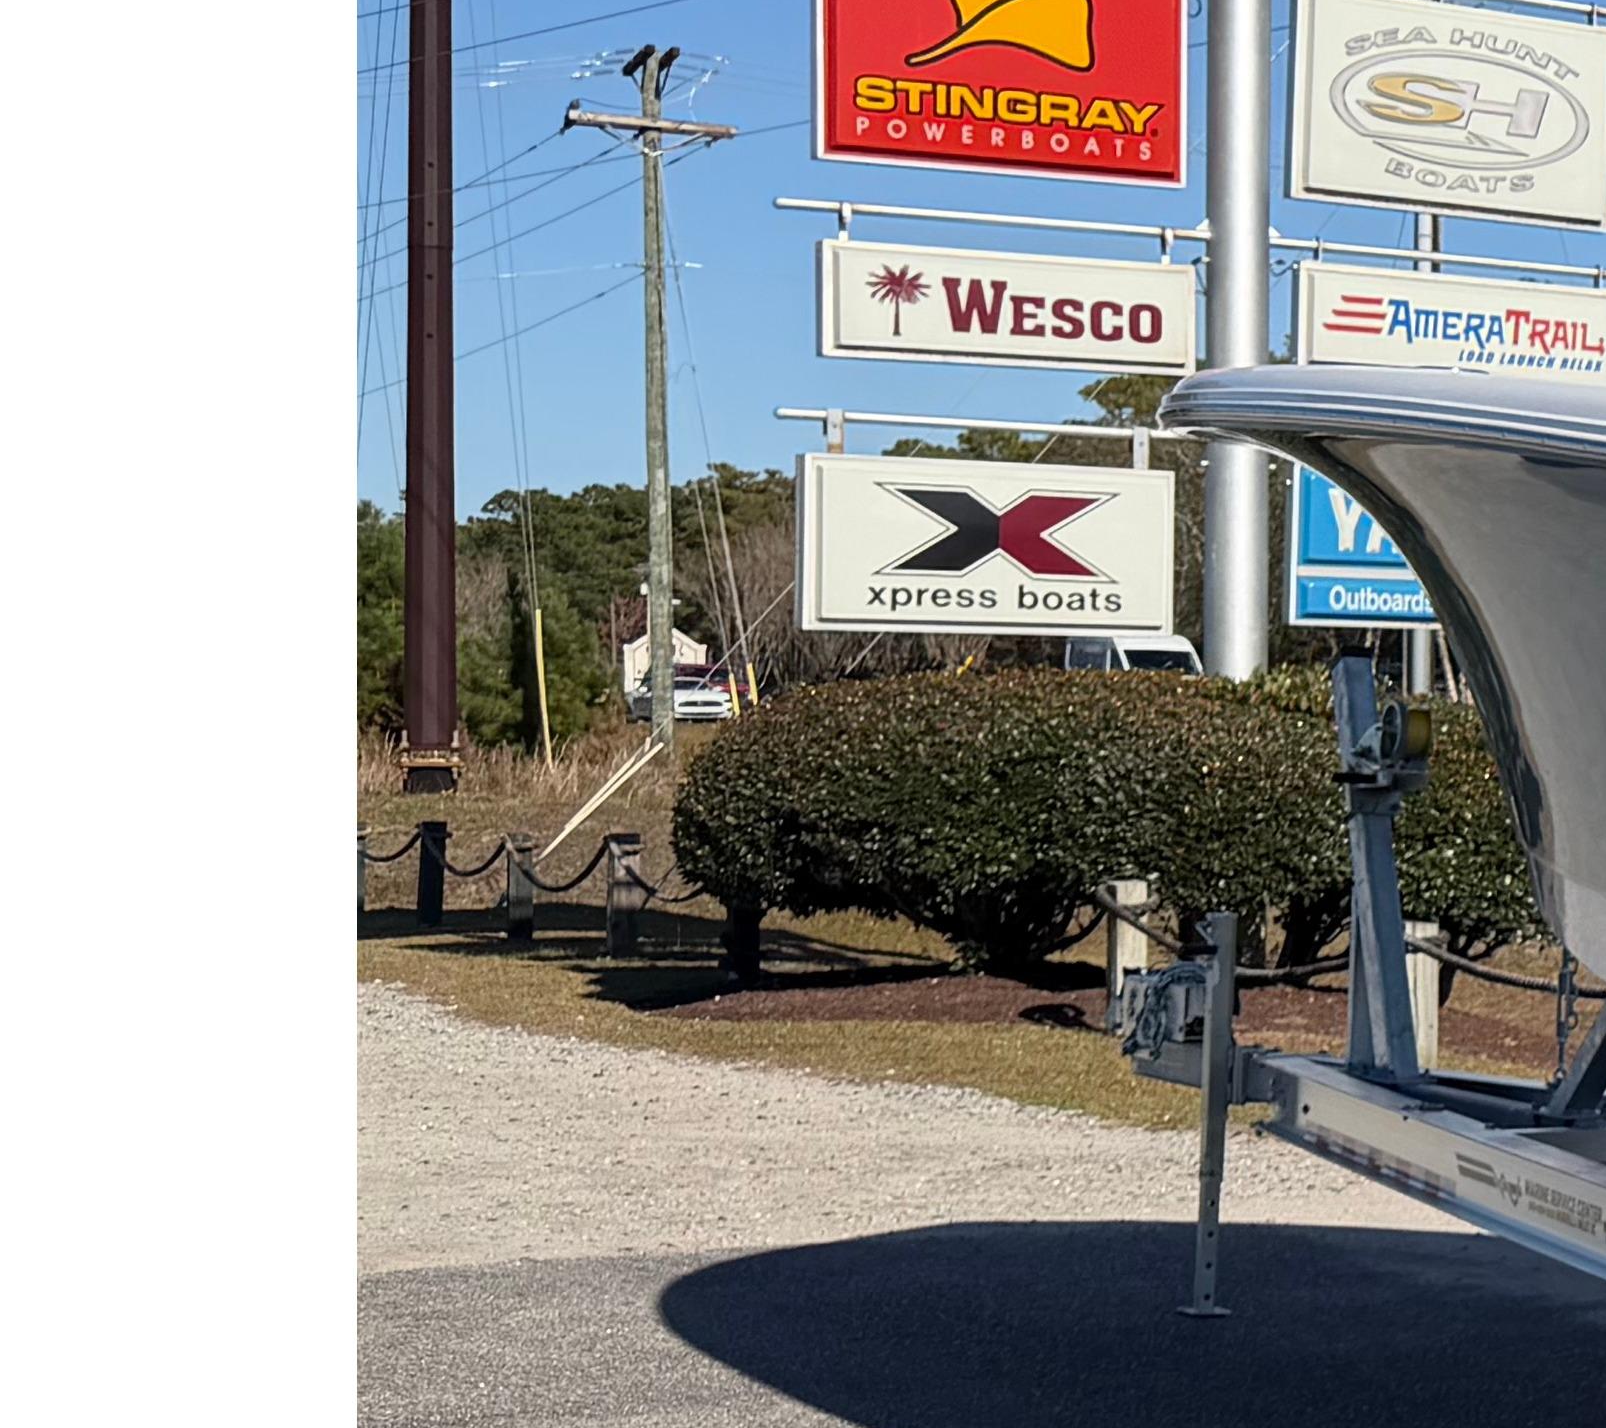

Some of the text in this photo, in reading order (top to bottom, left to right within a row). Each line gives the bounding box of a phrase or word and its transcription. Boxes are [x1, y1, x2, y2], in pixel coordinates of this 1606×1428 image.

[1345, 26, 1579, 80] SEA HUNT
[854, 75, 1164, 137] STINGRAY
[856, 115, 1152, 162] POWERBOATS
[1384, 157, 1535, 192] BOATS
[1458, 349, 1494, 365] LOAD
[1499, 352, 1555, 369] LAUNCH
[865, 584, 1122, 613] xpress boats
